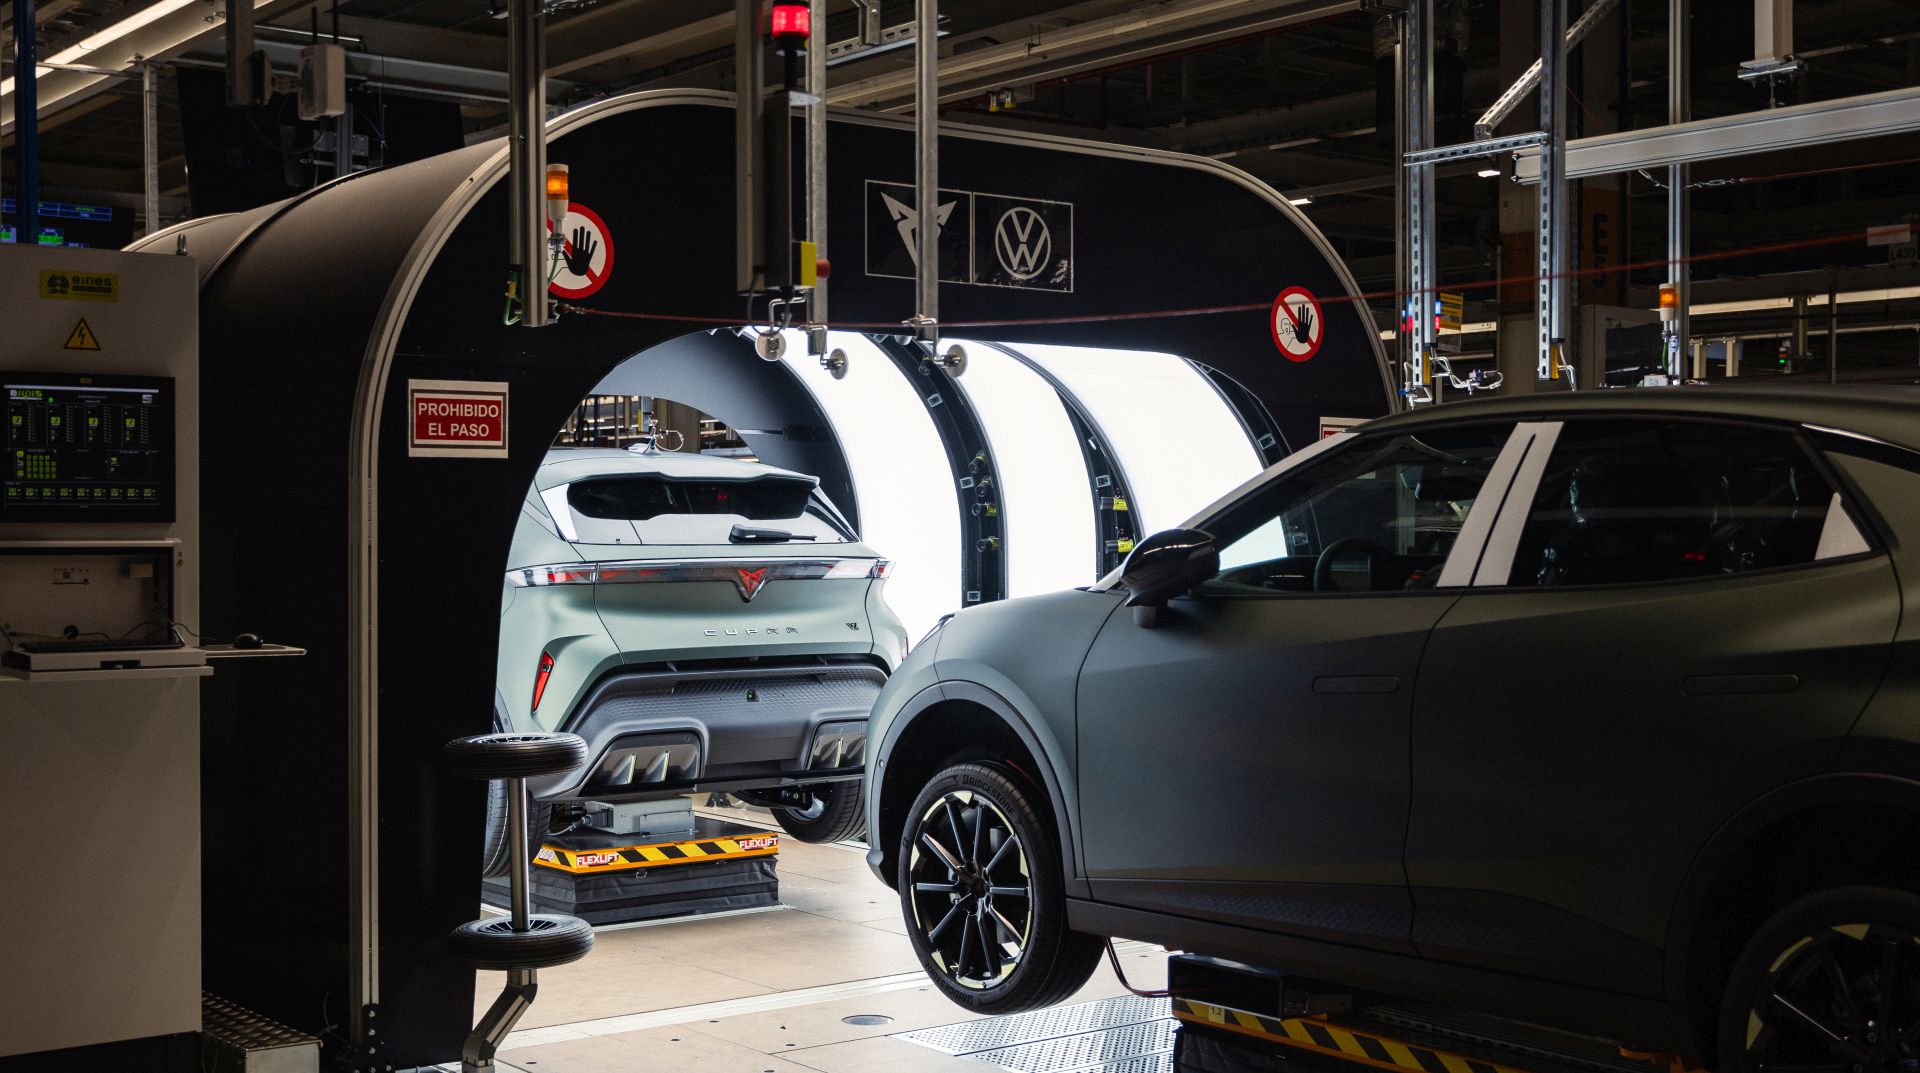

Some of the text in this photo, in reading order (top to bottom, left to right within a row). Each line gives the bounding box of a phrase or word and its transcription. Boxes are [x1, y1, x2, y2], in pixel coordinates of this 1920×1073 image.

[72, 275, 112, 286] eines
[418, 402, 499, 418] PROHIBIDO
[428, 422, 490, 437] EL PASO
[703, 626, 799, 637] CUPRA
[961, 774, 1016, 817] BRIDGESTONE
[739, 837, 778, 849] FLEXLIFT
[576, 853, 619, 866] FLEXLIFT
